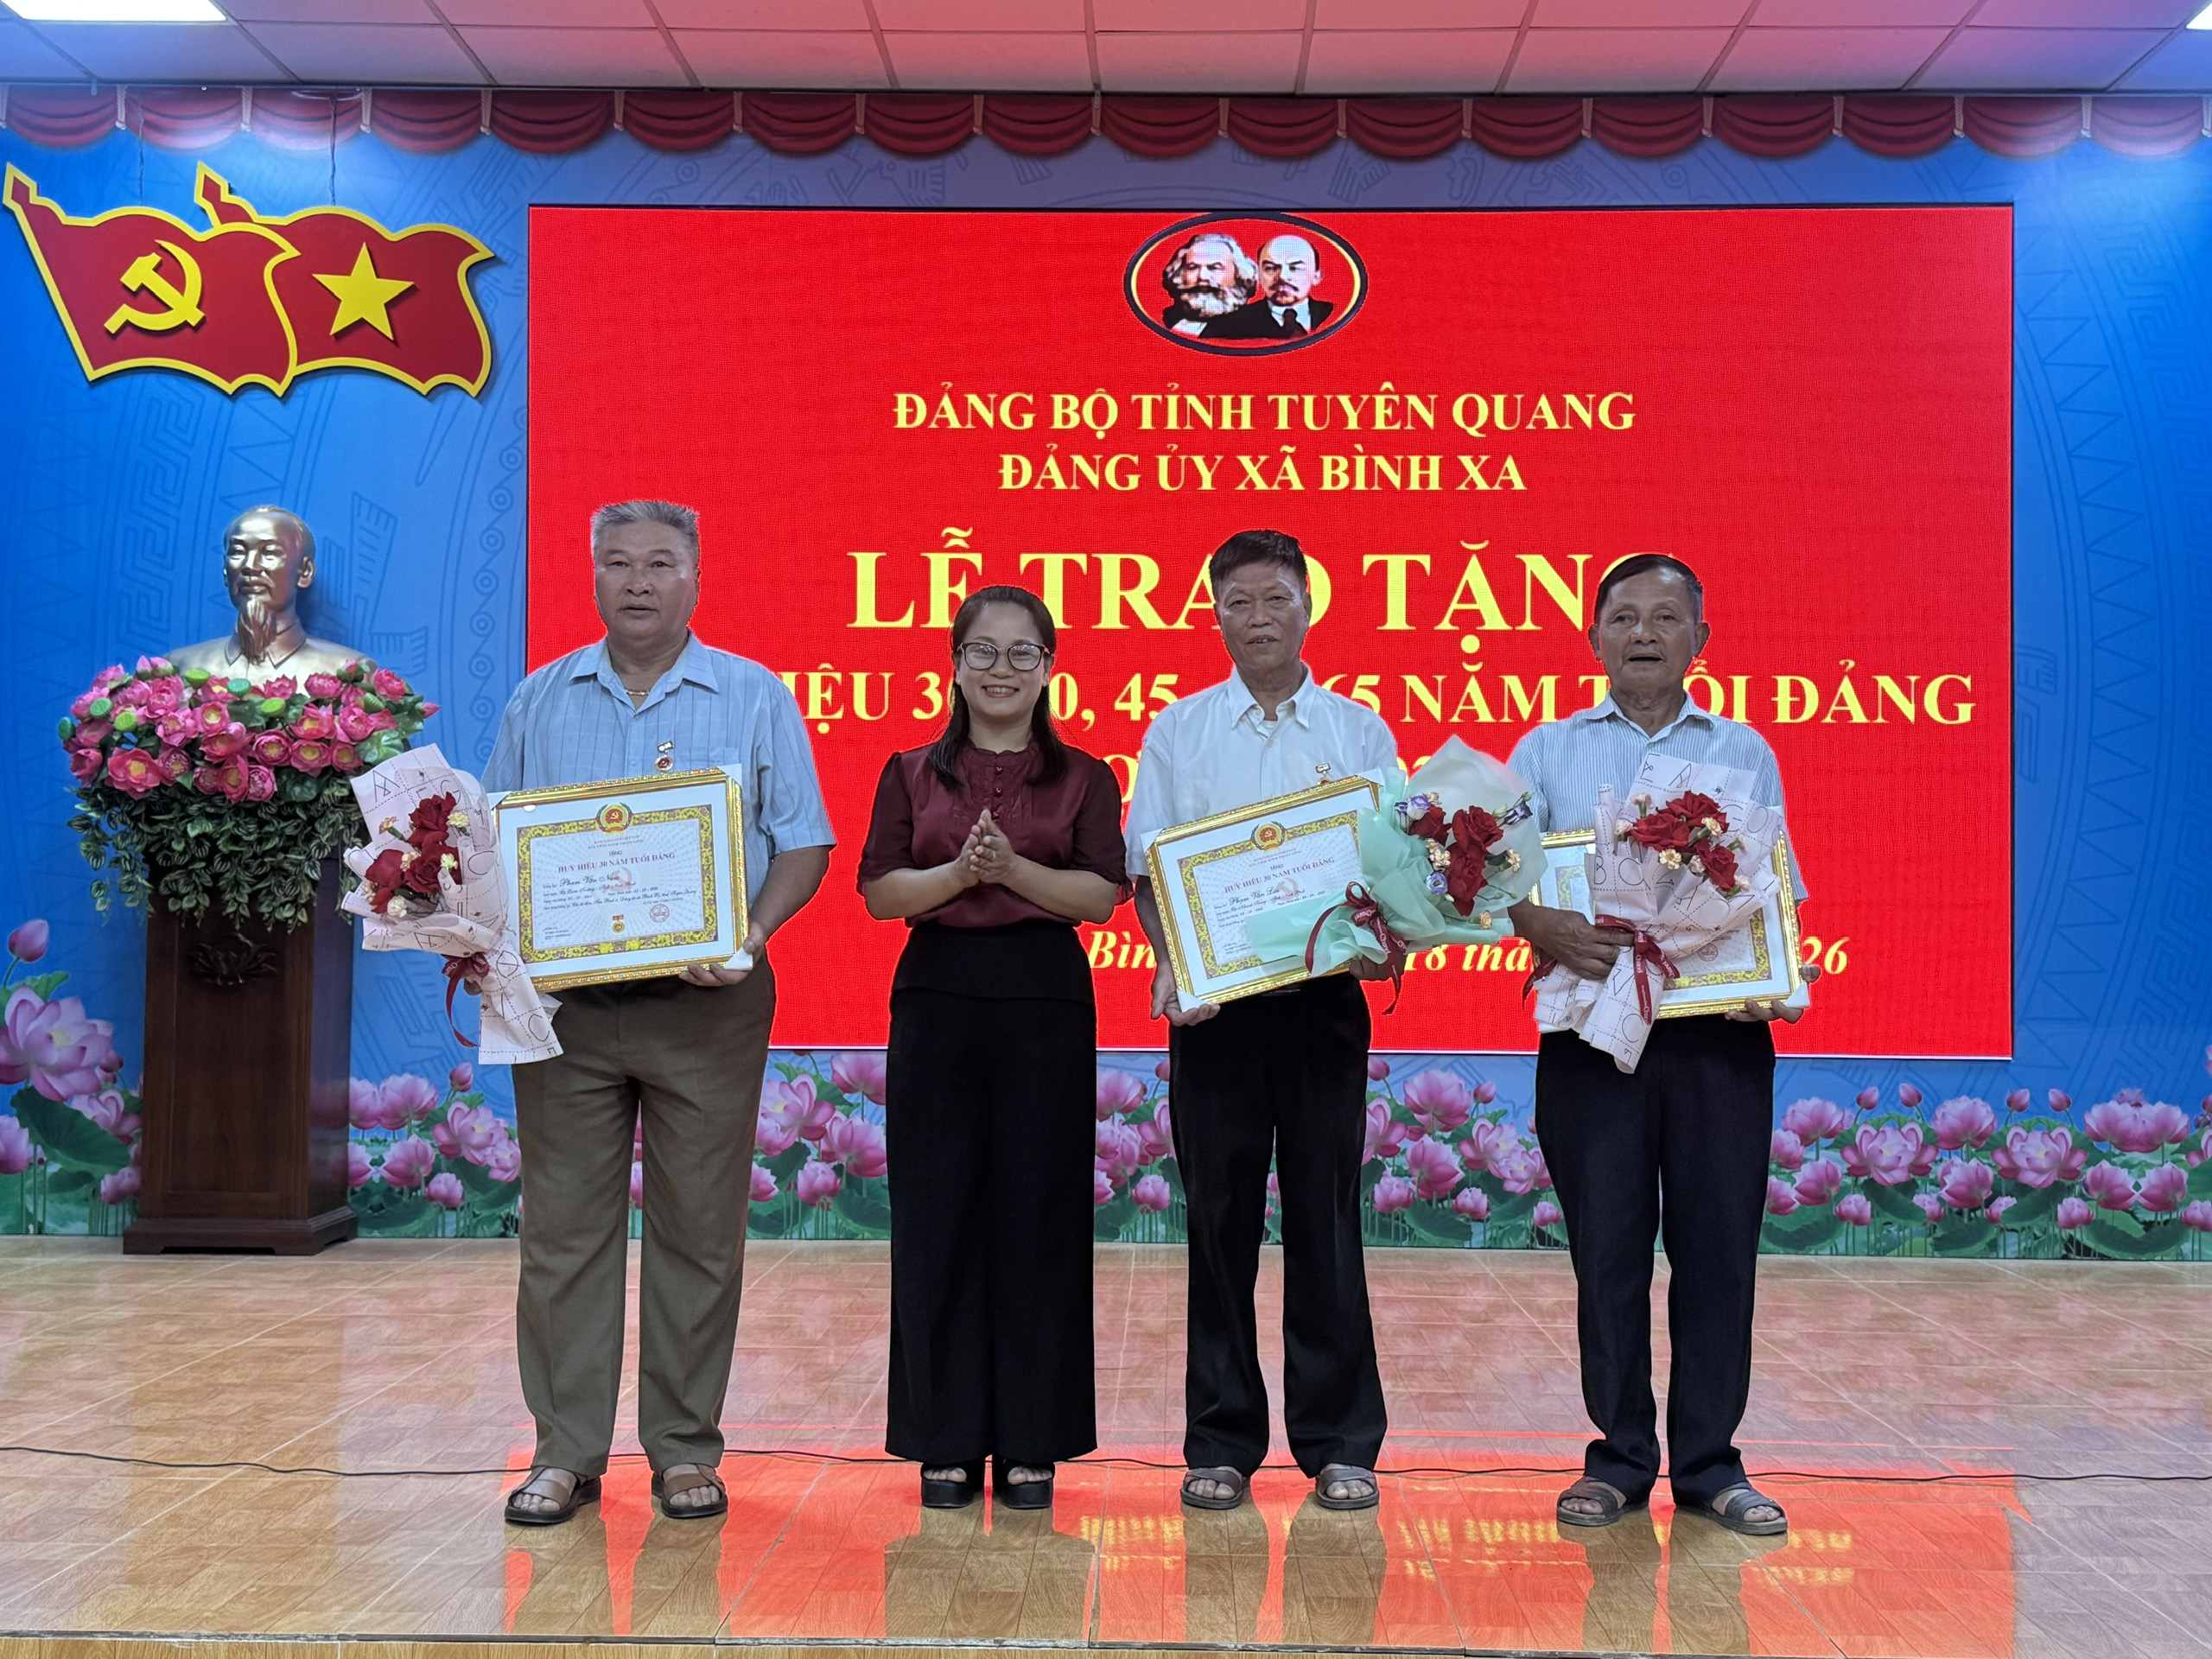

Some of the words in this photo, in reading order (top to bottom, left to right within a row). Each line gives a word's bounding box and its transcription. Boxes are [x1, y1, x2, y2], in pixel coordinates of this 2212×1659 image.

[893, 382, 1035, 430] ĐẢNG
[1052, 388, 1119, 440] BỘ
[1131, 384, 1254, 430] TỈNH
[1268, 381, 1438, 431] TUYÊN
[1452, 391, 1636, 438] QUANG
[998, 443, 1141, 492] ĐẢNG
[1156, 443, 1224, 492] ỦY
[1236, 443, 1306, 491] XÃ
[1320, 444, 1442, 491] BÌNH
[1457, 454, 1528, 491] XA
[847, 526, 983, 629] LỄ
[1020, 553, 1332, 630] TRA
[1363, 540, 1674, 654] TẶN
[779, 662, 895, 734] IỆU
[912, 671, 955, 720] 3
[1048, 672, 1096, 732] 0,
[1321, 674, 1381, 715] 5
[1400, 661, 1559, 723] NĂM
[1578, 659, 1752, 724] TỔI
[1771, 659, 1977, 725] ĐẢNG
[1088, 931, 1158, 969] Bìn
[1462, 937, 1532, 972] thá
[1802, 936, 1851, 975] 26
